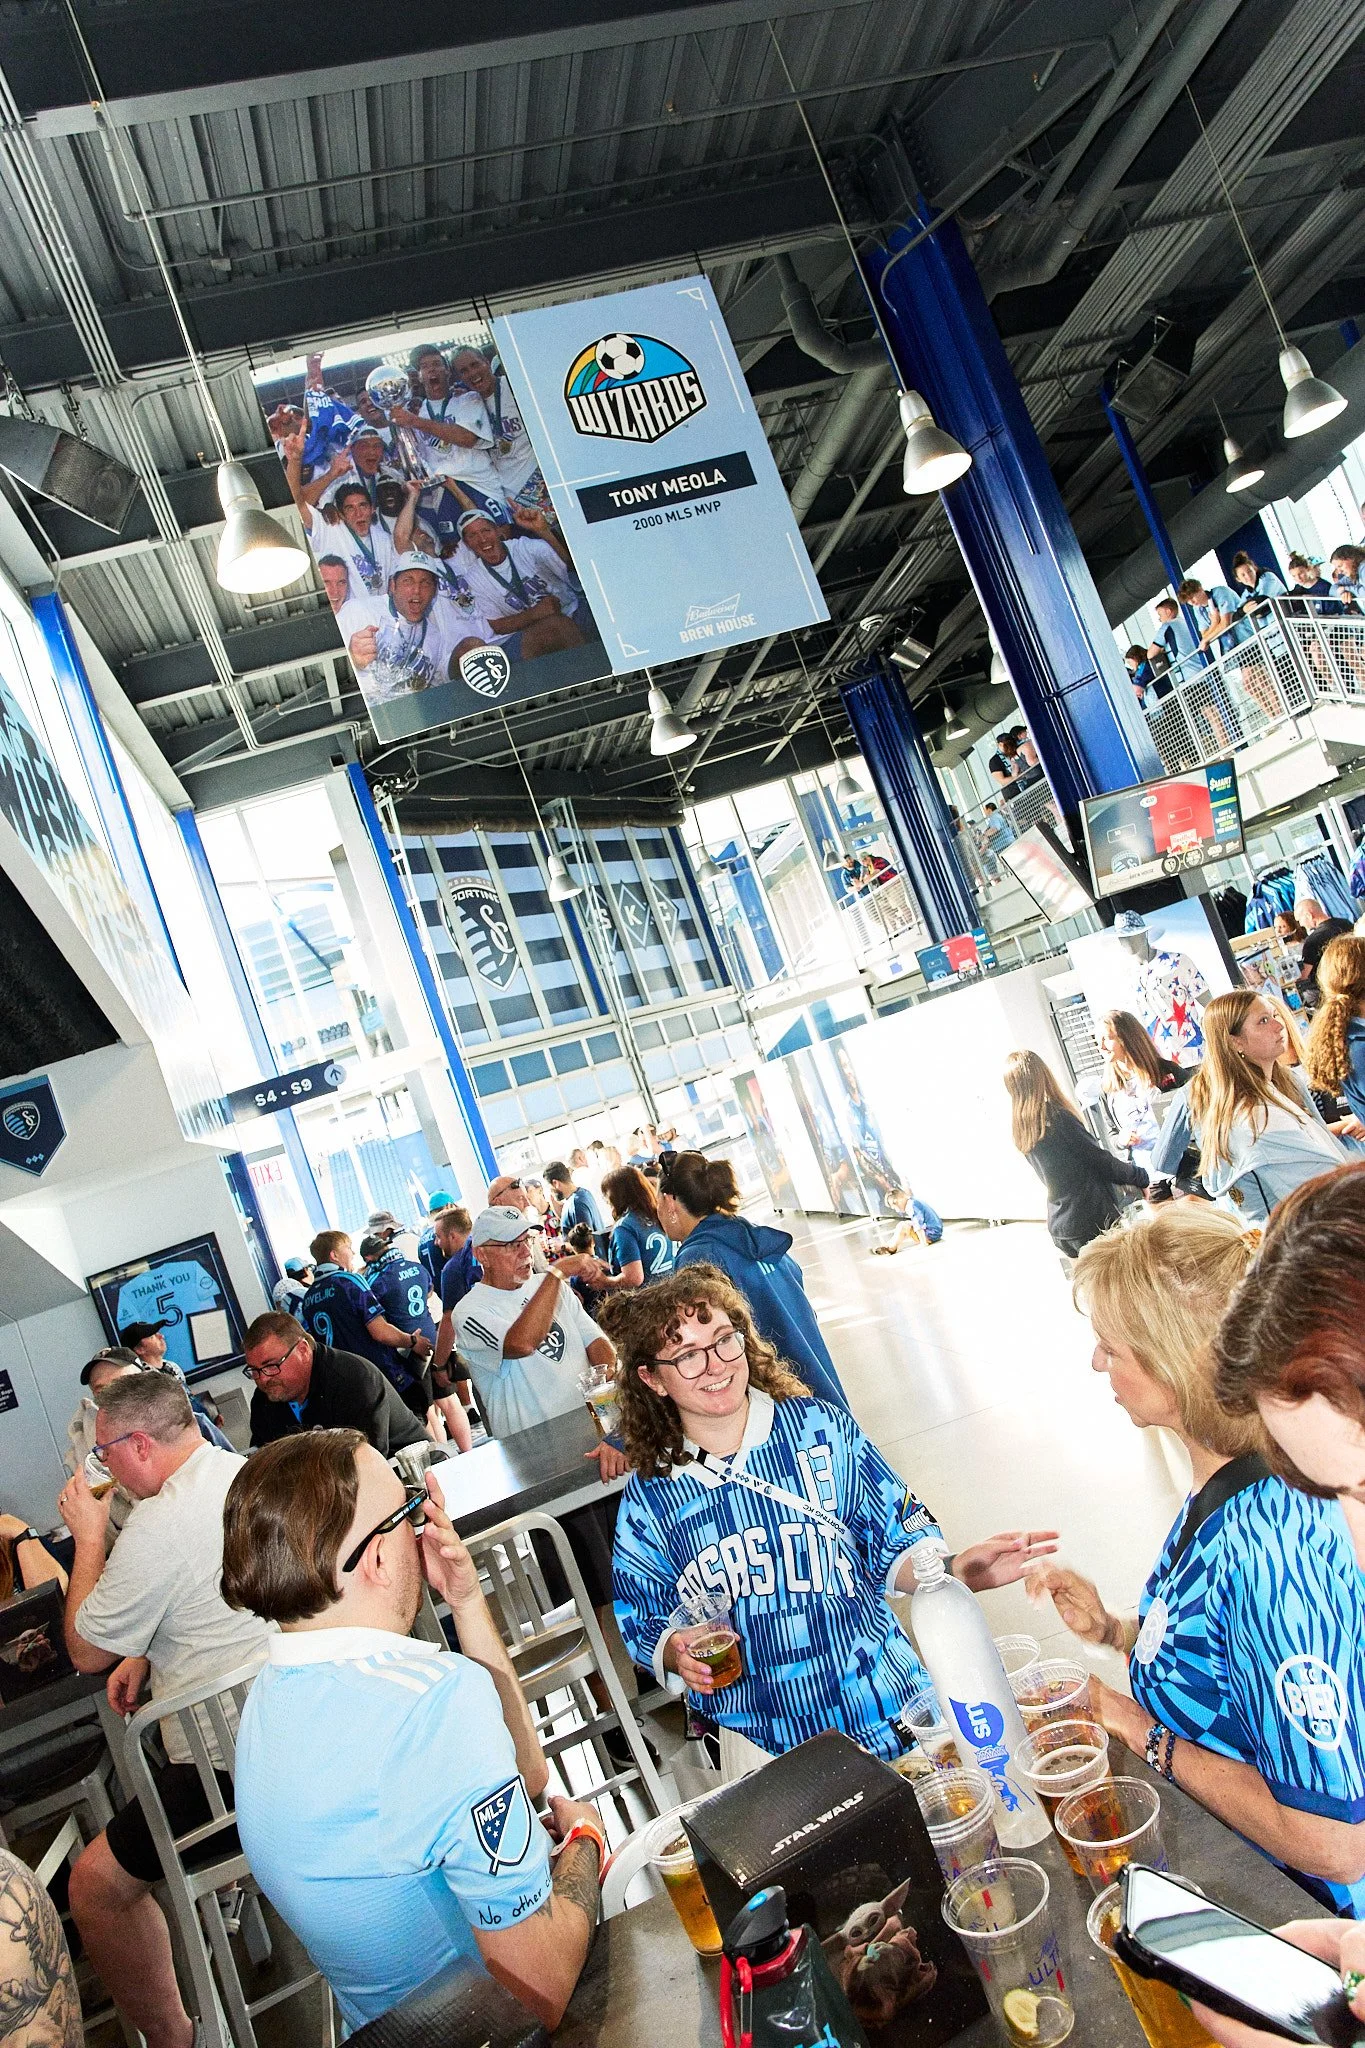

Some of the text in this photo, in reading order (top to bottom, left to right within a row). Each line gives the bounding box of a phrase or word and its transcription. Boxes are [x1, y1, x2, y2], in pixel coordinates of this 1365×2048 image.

[568, 370, 705, 440] WIZARDS
[608, 467, 728, 508] TONY MEOLA
[632, 500, 722, 531] 2000 MLS MVP
[678, 612, 758, 644] BREW HOUSE
[688, 601, 739, 623] Budweiser
[624, 905, 641, 927] K
[254, 1089, 278, 1107] S4
[290, 1078, 313, 1096] S9
[132, 1272, 191, 1299] THANK YOU
[398, 1266, 420, 1281] JONES
[155, 1291, 184, 1327] 5
[407, 1284, 425, 1318] 8
[312, 1311, 334, 1348] 9
[796, 1444, 838, 1513] 13
[802, 1504, 846, 1535] SPORTING KC
[478, 1797, 507, 1827] MLS
[770, 1790, 865, 1856] STAR WARS
[478, 1905, 502, 1926] No
[511, 1888, 543, 1918] other
